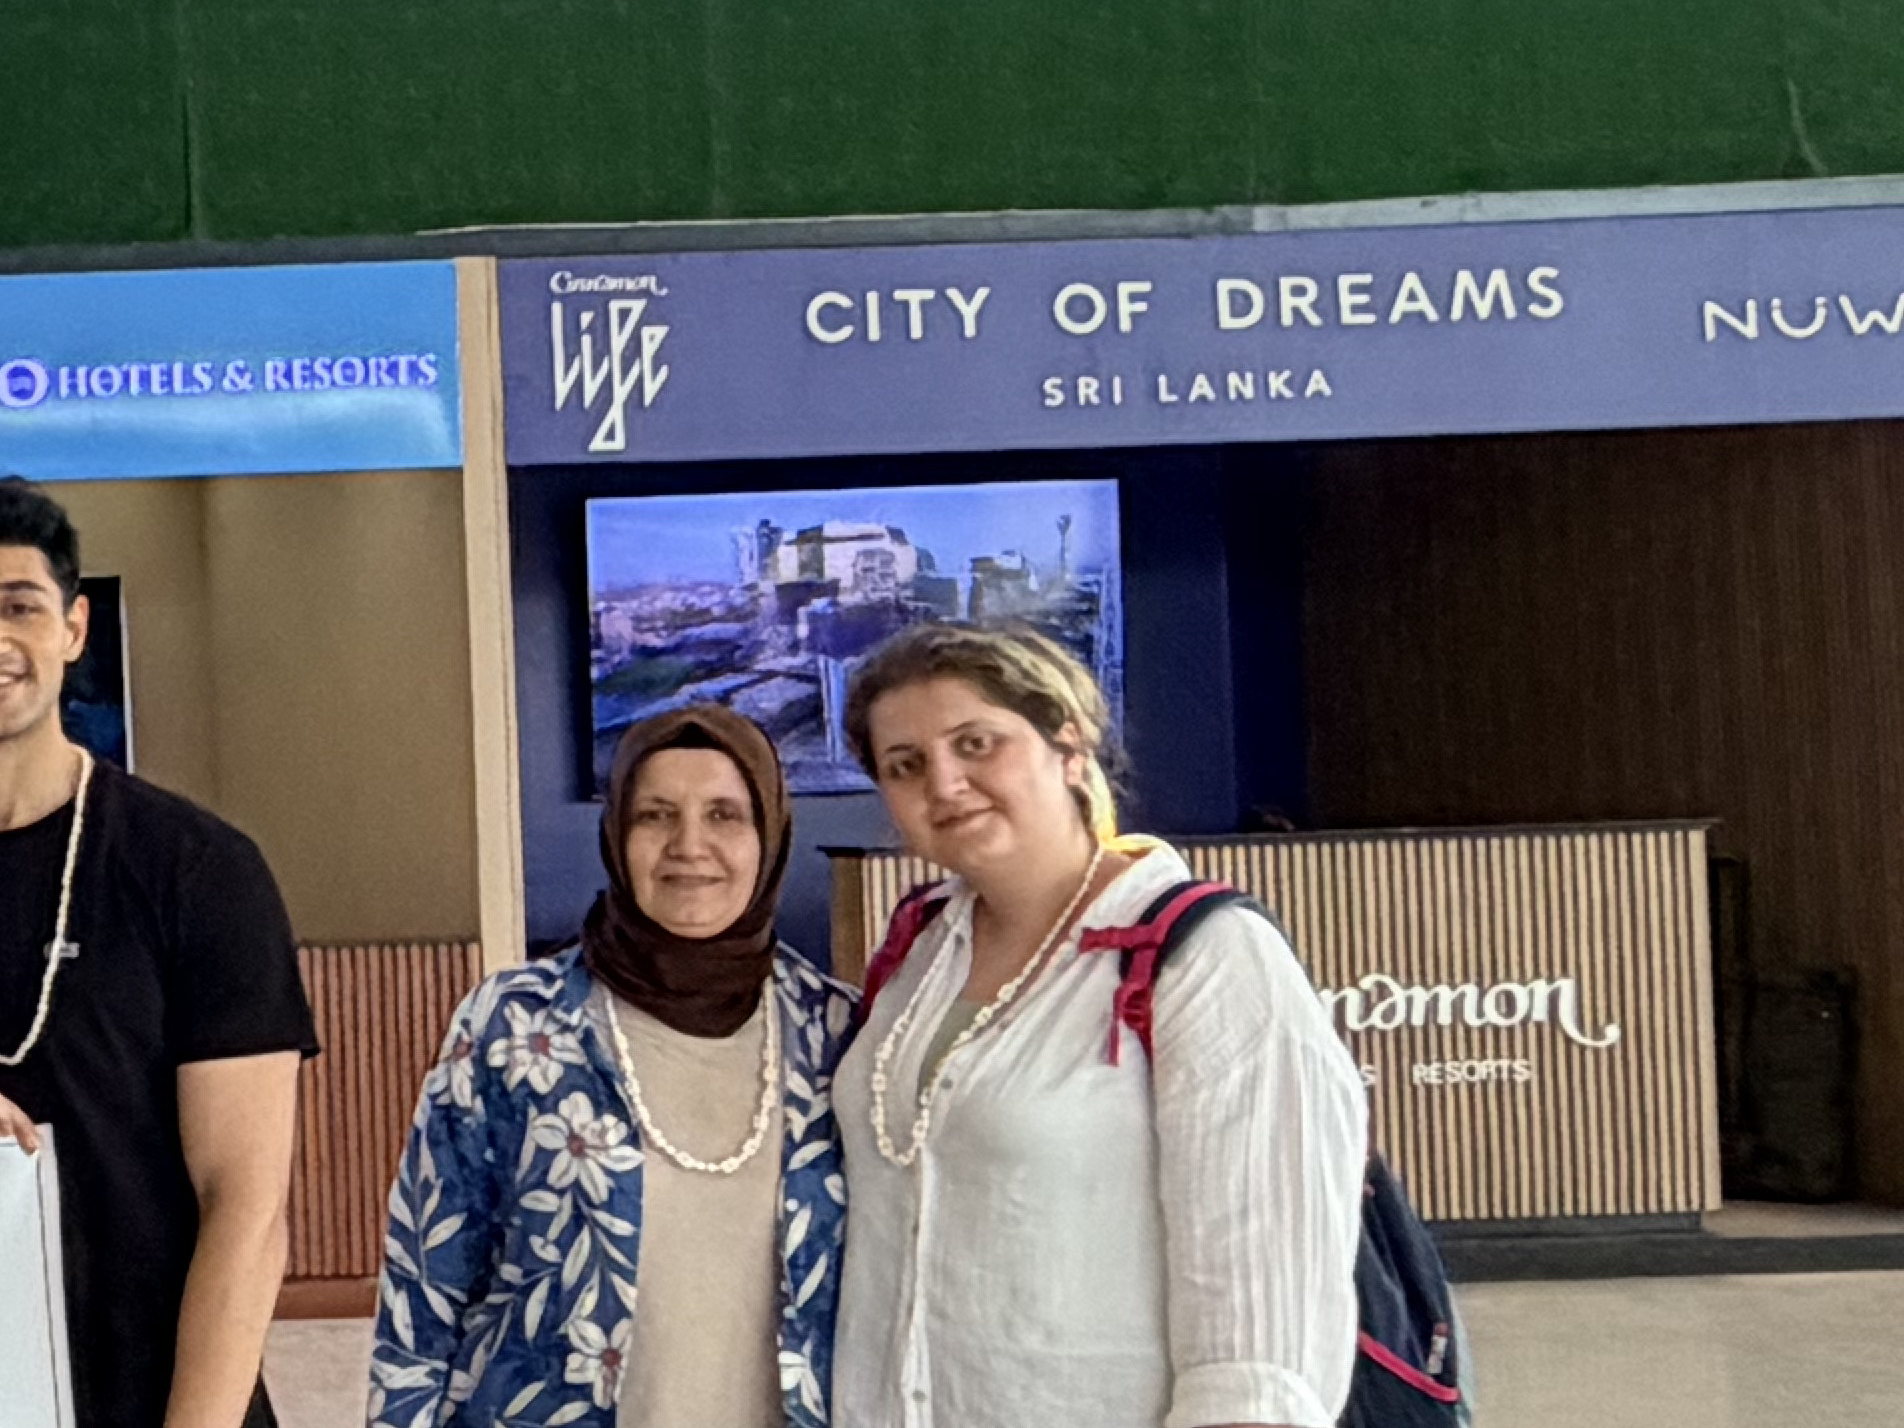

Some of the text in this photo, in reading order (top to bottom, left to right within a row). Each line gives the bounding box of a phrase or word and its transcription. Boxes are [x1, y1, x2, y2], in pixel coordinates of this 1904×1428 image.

[805, 266, 1565, 344] CITY OF DREAMS
[58, 360, 212, 399] HOTELS
[221, 359, 255, 394] &
[264, 352, 439, 392] RESORTS
[1042, 369, 1333, 407] SRI LANKA
[1411, 1058, 1533, 1086] RESORTS
